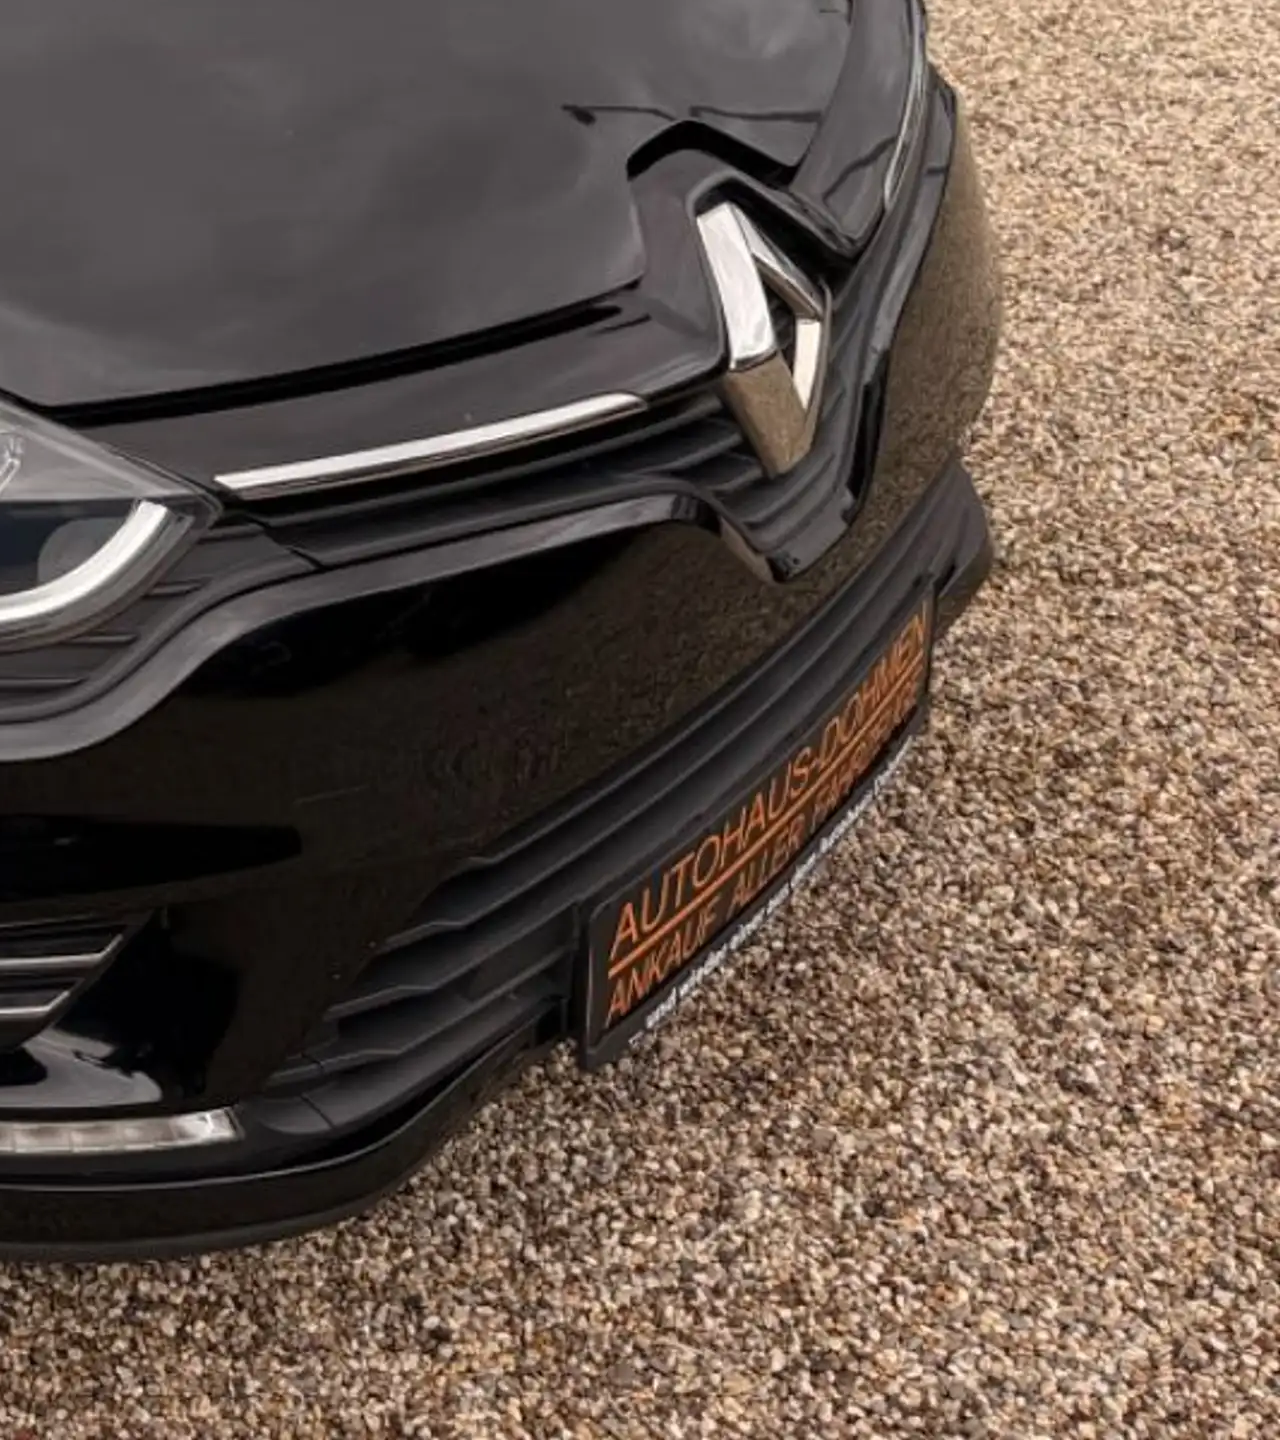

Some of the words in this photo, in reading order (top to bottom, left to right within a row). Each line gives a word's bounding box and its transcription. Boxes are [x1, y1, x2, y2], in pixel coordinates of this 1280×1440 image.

[605, 894, 723, 1029] ANKAUF
[726, 812, 806, 920] ALLER
[610, 600, 928, 962] AUTOHAUS-DOHMEN
